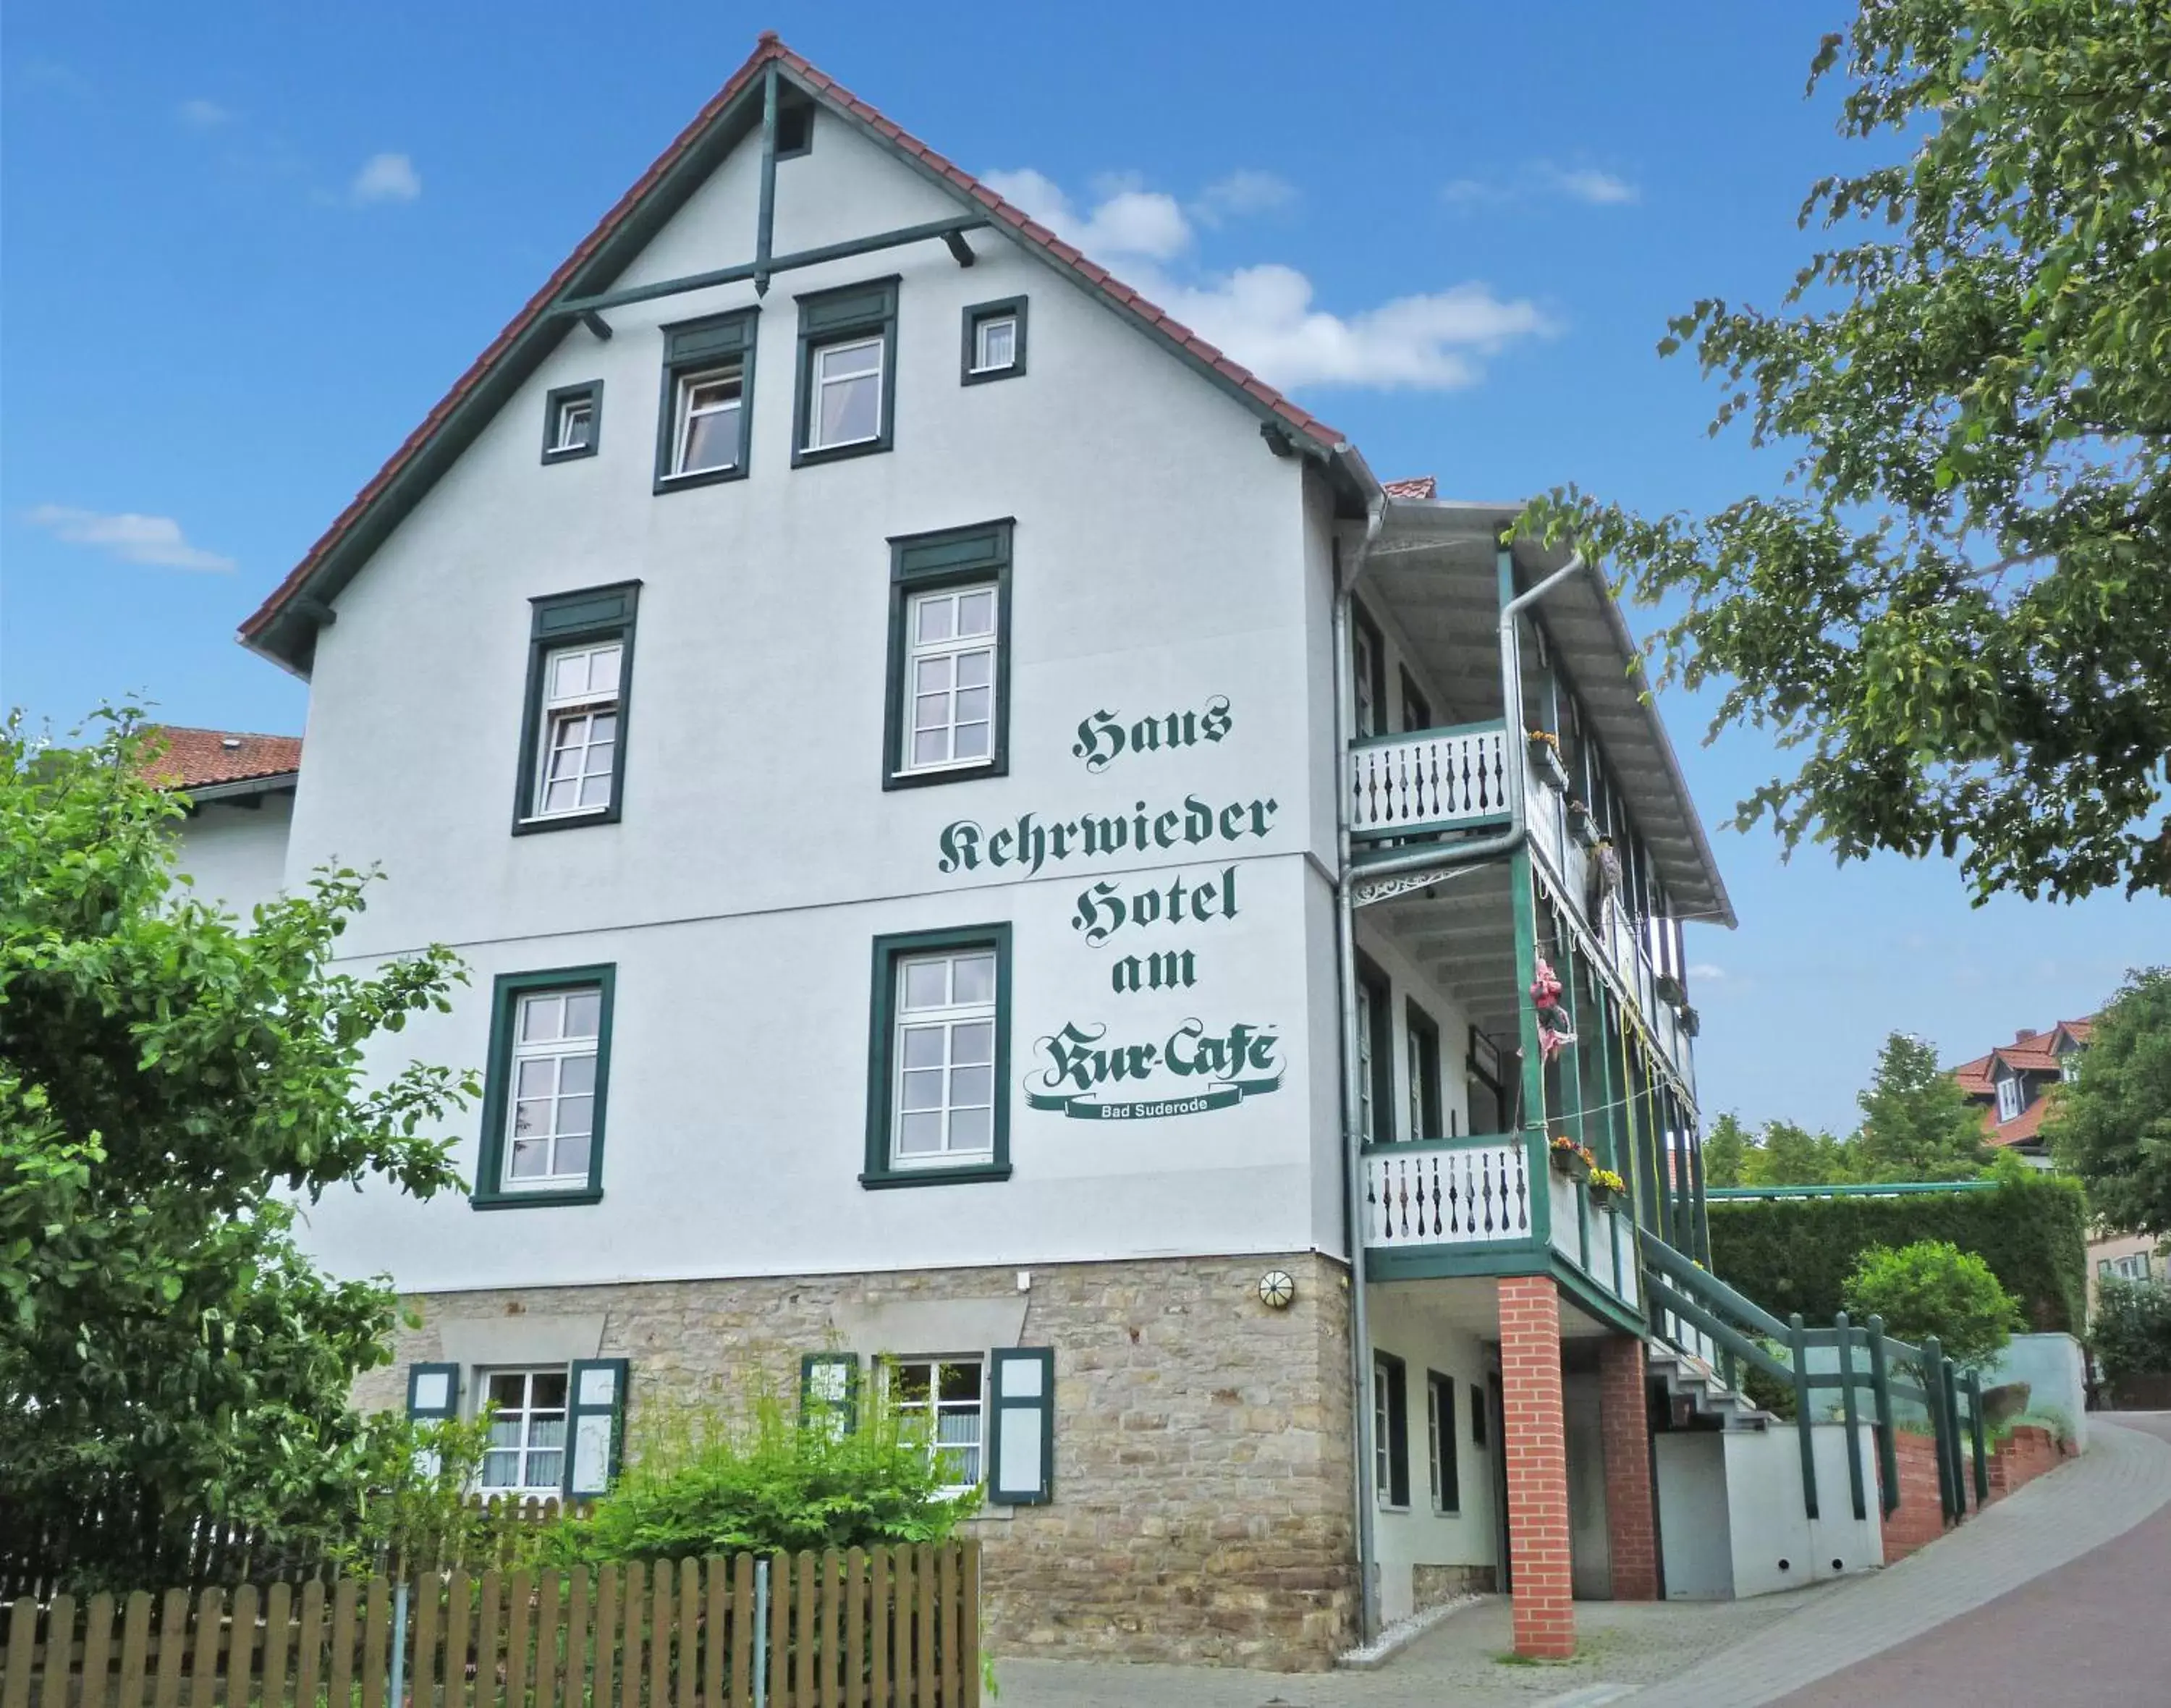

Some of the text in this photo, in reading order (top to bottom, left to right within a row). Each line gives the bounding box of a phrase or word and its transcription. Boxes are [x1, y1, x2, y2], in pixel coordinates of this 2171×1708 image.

[1072, 693, 1232, 774] Haus
[938, 793, 1279, 879] Kehrwieder
[1071, 864, 1242, 948] Hotel
[1112, 949, 1198, 994] am
[1101, 1098, 1209, 1118] Bad Suderode
